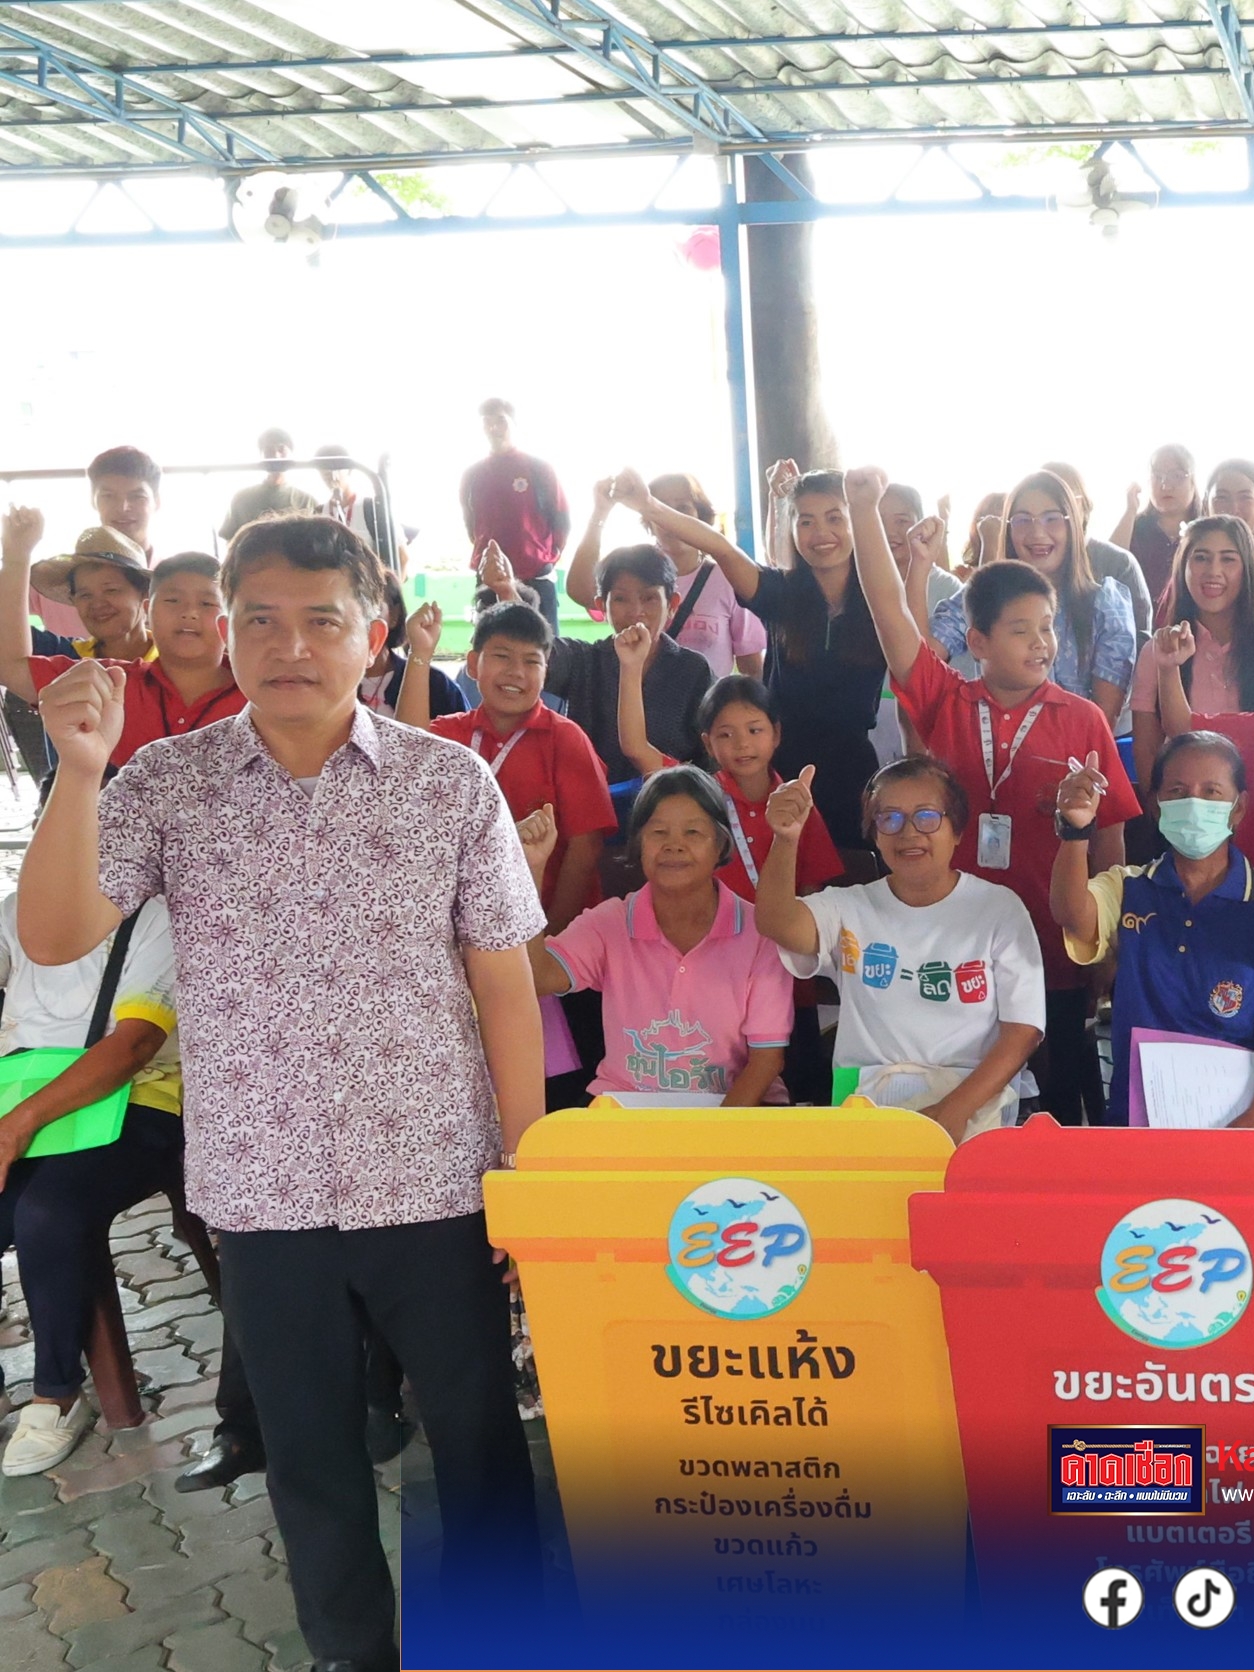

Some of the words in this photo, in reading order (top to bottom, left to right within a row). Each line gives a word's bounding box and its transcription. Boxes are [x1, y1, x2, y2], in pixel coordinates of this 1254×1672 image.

[864, 963, 891, 978] ขยะ
[960, 975, 986, 994] ขยะ
[675, 1220, 806, 1268] EEP
[1108, 1244, 1247, 1294] EEP
[651, 1329, 856, 1379] ขยะแห้ง
[680, 1395, 829, 1427] รีไซเคิลได้
[679, 1456, 841, 1479] ขวดพลาสติก
[654, 1487, 872, 1519] กระป๋องเครื่องดื่ม
[713, 1531, 818, 1557] ขวดแก้ว
